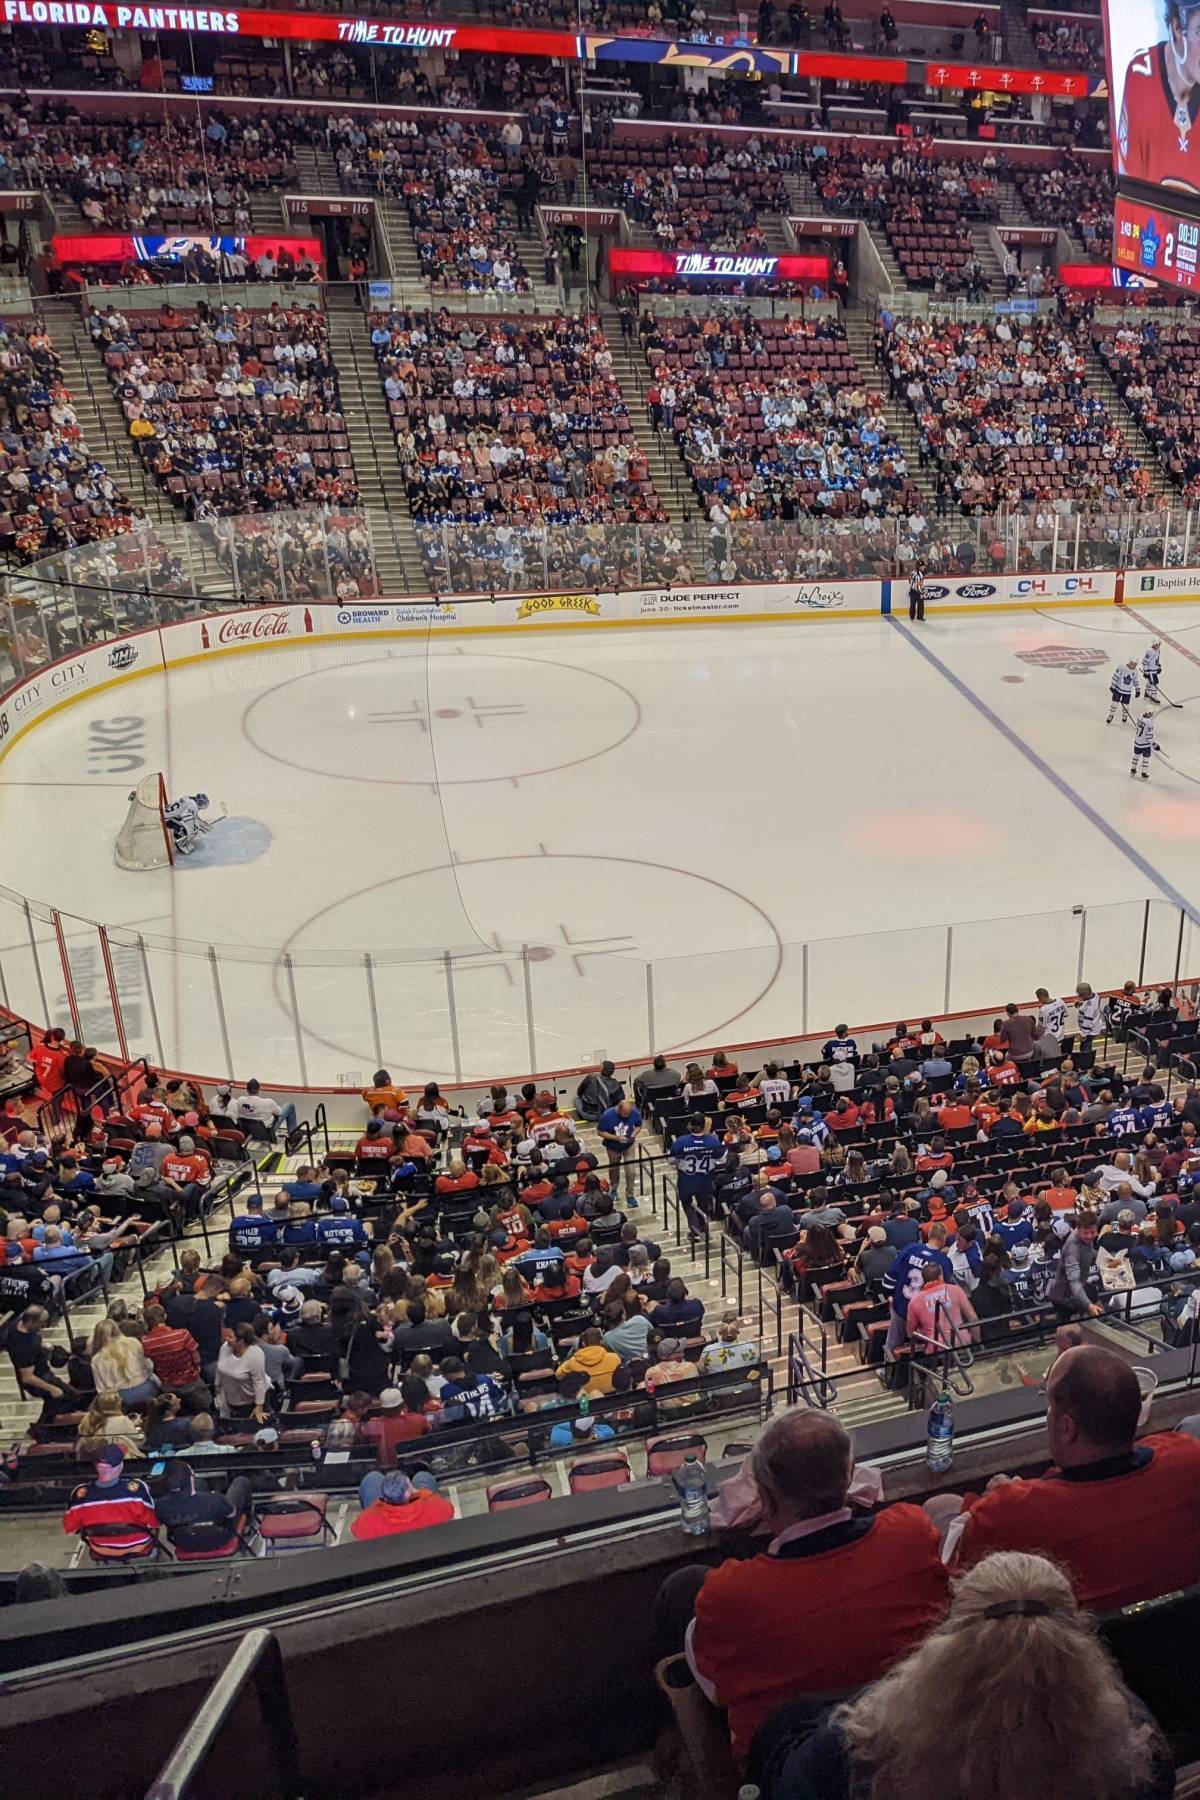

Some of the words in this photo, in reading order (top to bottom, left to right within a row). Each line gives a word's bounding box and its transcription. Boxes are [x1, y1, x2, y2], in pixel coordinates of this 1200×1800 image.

[4, 0, 108, 25] FLORIDA
[117, 6, 239, 32] PANTHERS
[338, 21, 379, 42] TIME
[383, 26, 405, 44] TO
[406, 27, 457, 47] HUNT
[292, 201, 308, 212] 115
[353, 203, 369, 214] 116
[546, 212, 560, 222] 116
[600, 214, 614, 225] 117
[841, 224, 855, 234] 118
[1178, 223, 1199, 246] 00:10
[1164, 233, 1174, 267] 2
[676, 254, 711, 272] TIME
[715, 256, 735, 273] TO
[735, 257, 778, 275] HUNT
[1018, 579, 1046, 593] CH
[1065, 577, 1092, 590] CH
[1157, 577, 1186, 589] Baptist
[660, 594, 690, 602] DUDE
[693, 592, 740, 601] PERFECT
[794, 586, 845, 605] LaCroix
[962, 585, 991, 597] Ford
[525, 599, 554, 611] GOOD
[560, 597, 593, 610] GREEK
[352, 609, 389, 617] BROWARD
[352, 616, 381, 624] HEALTH
[396, 614, 428, 622] Children's
[429, 613, 457, 622] Hospital
[108, 647, 139, 666] NHL
[51, 660, 88, 687] CITY
[14, 682, 41, 712] CITY
[40, 1063, 52, 1077] 7
[685, 1155, 711, 1175] 34
[977, 1210, 994, 1233] 11
